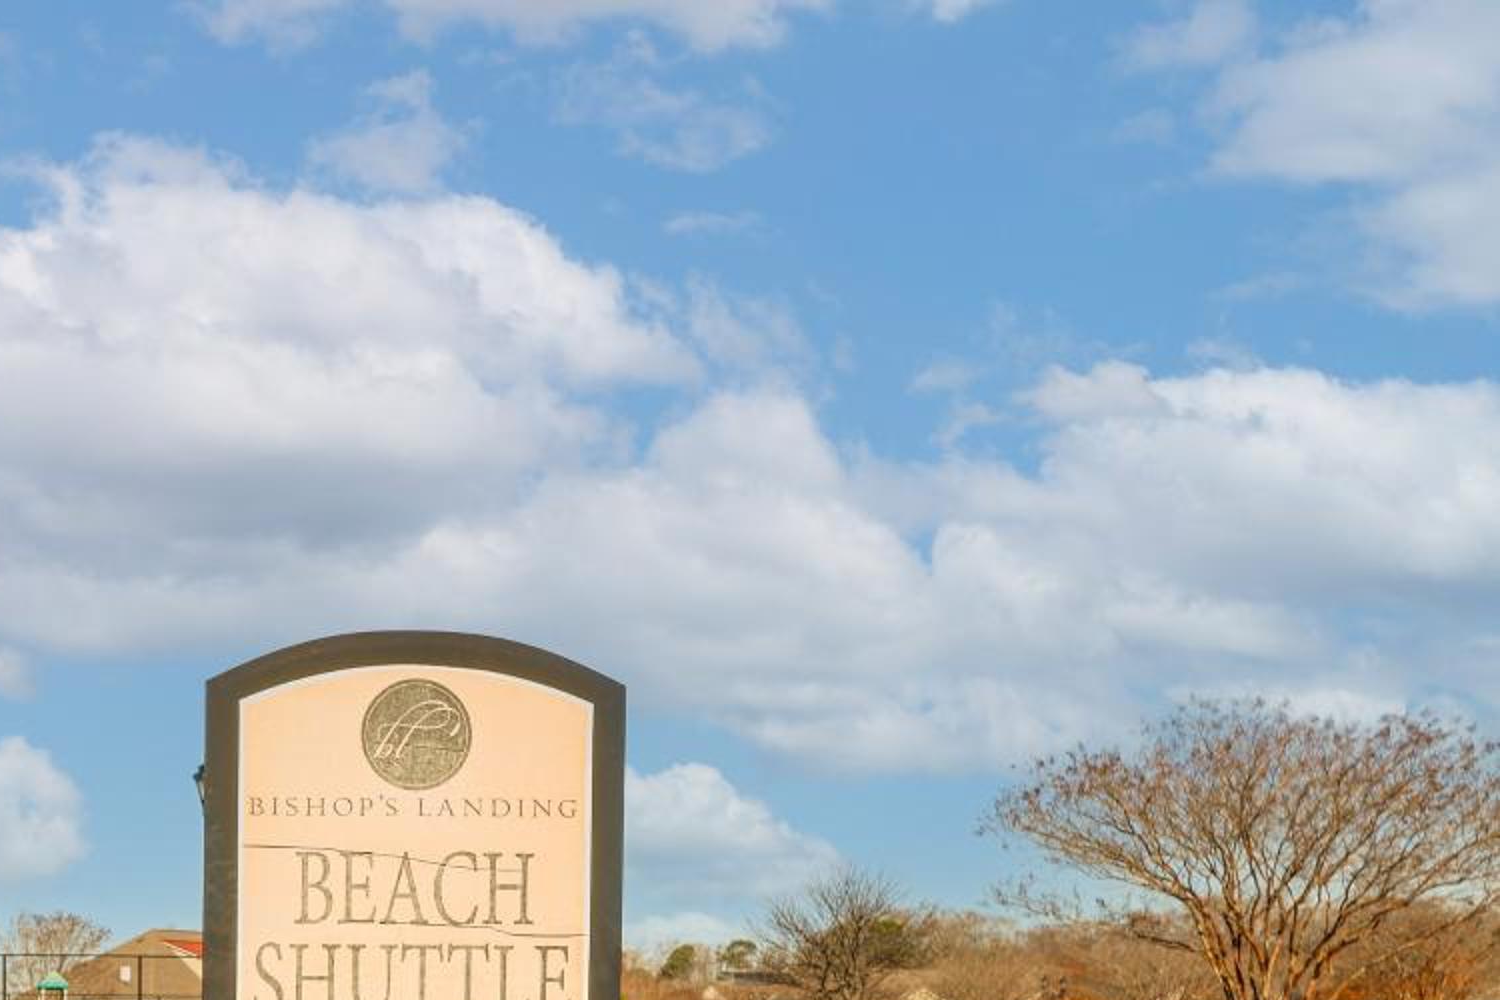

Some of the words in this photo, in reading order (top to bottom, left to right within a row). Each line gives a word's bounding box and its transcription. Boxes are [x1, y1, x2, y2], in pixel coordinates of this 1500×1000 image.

[247, 794, 398, 817] BISHOP'S
[417, 798, 578, 818] LANDING
[294, 852, 535, 925] BEACH
